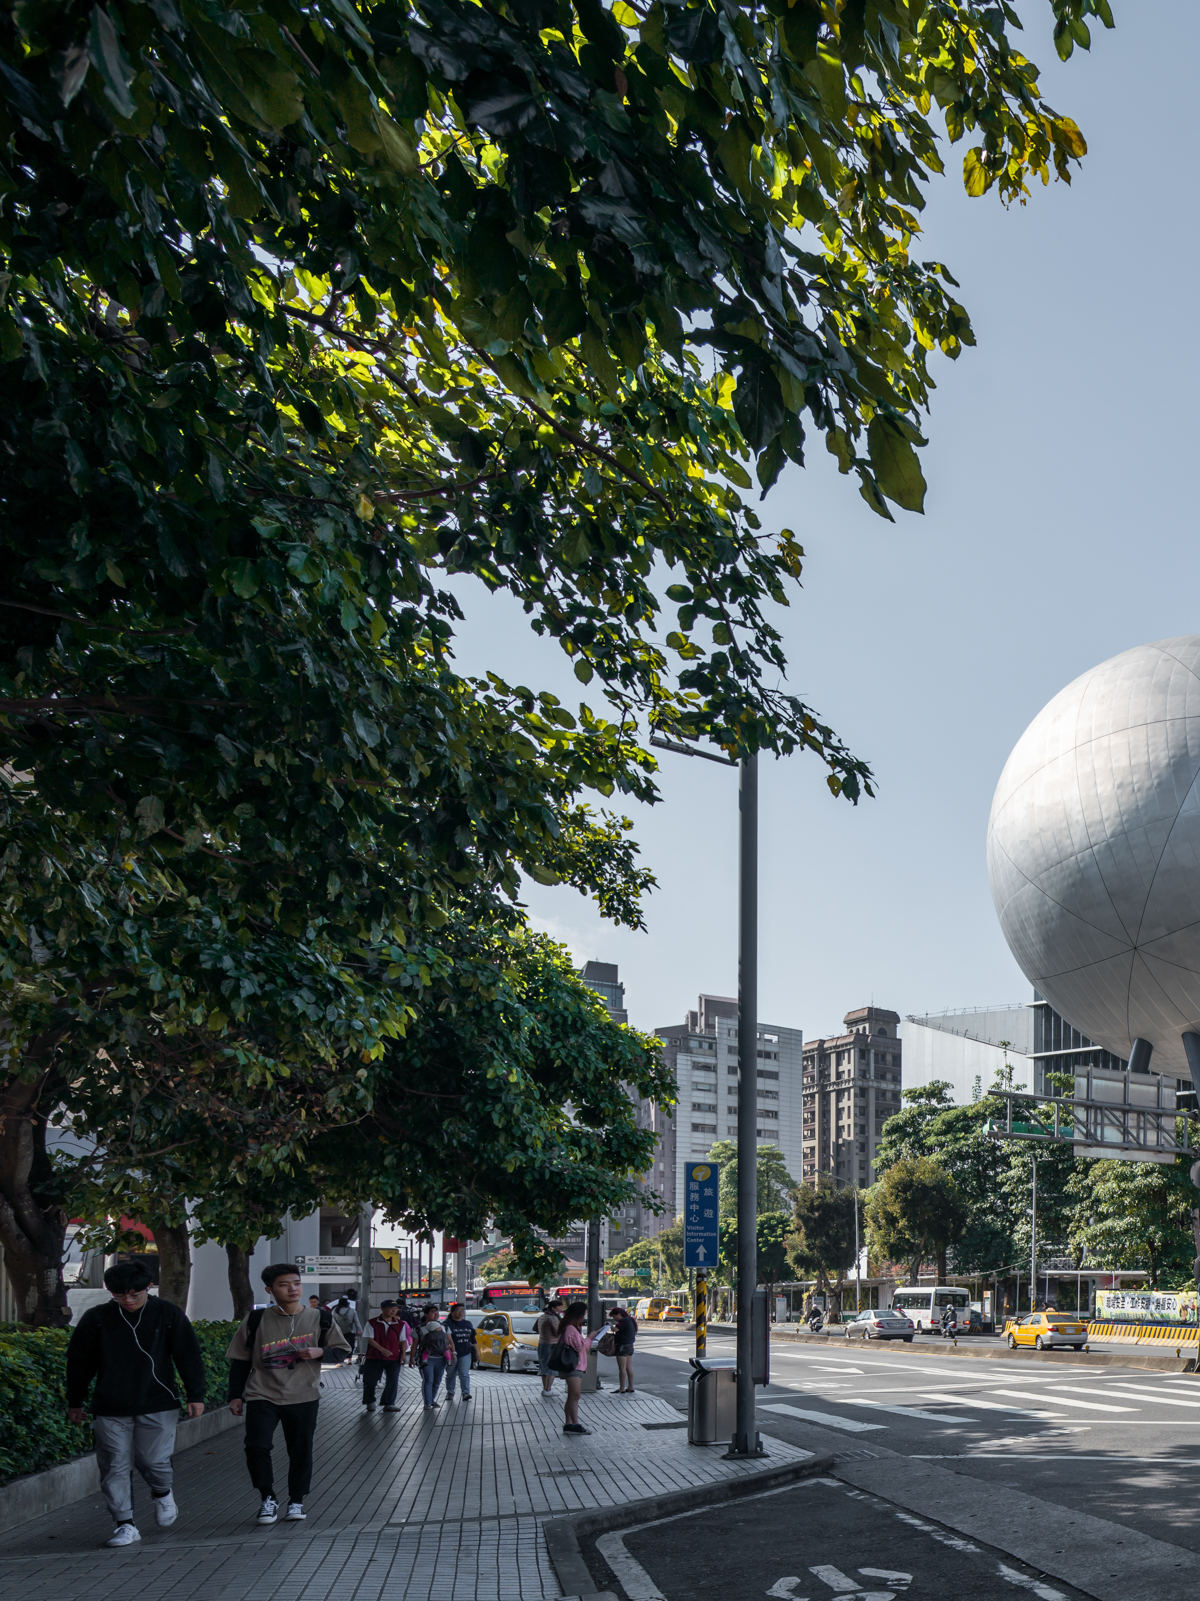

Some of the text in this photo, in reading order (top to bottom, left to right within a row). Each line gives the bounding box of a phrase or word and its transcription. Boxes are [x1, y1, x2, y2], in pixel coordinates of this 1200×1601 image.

[689, 1181, 700, 1223] 服務中心
[703, 1187, 714, 1218] 旅遊
[384, 1256, 393, 1273] 1
[275, 1338, 289, 1349] MY
[290, 1333, 313, 1345] DUST
